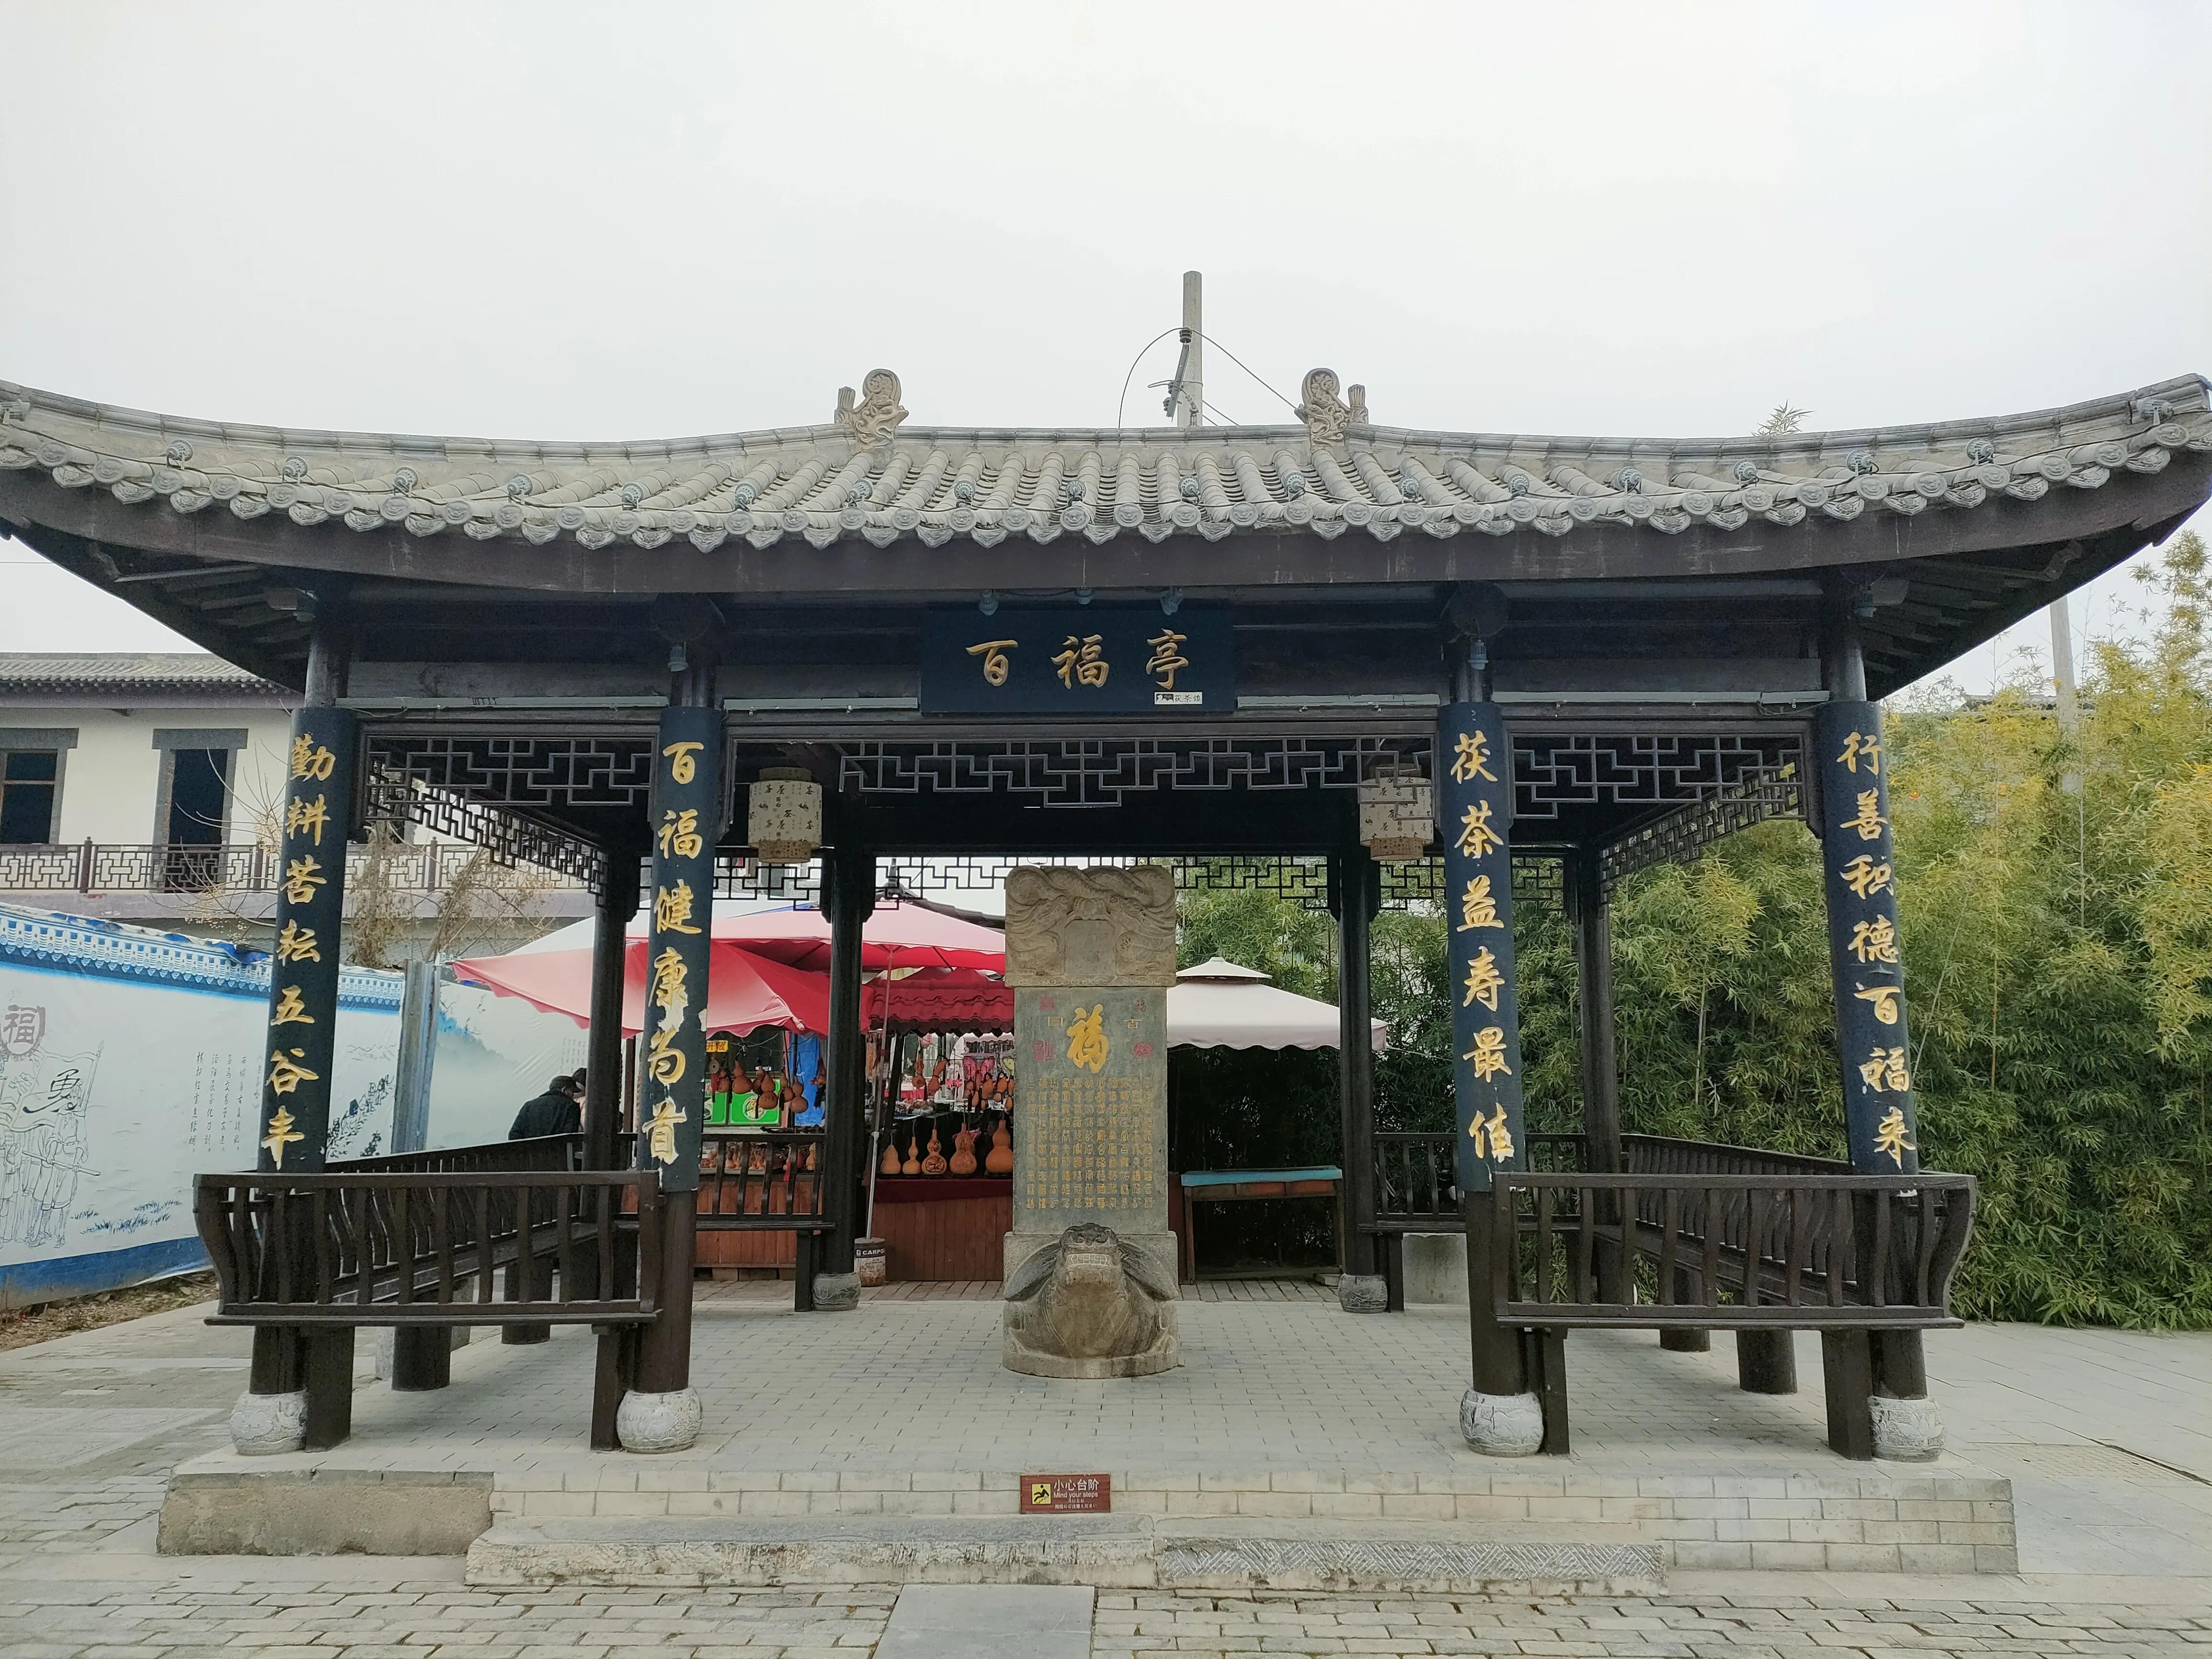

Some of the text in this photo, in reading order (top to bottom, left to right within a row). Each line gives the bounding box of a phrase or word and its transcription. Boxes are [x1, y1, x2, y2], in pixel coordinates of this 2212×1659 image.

[965, 628, 1189, 690] 百福亭
[1174, 694, 1201, 703] 茯茶镇
[262, 733, 335, 1170] 勤耕苦耘五谷丰
[642, 741, 705, 1164] 百福健康为首
[1450, 730, 1515, 1163] 茯茶益寿最佳
[1836, 731, 1916, 1170] 行善积德百福来
[3, 1004, 37, 1044] 福
[1066, 1003, 1109, 1074] 福
[22, 1068, 80, 1114] 勇
[1053, 1478, 1099, 1492] 小心台阶
